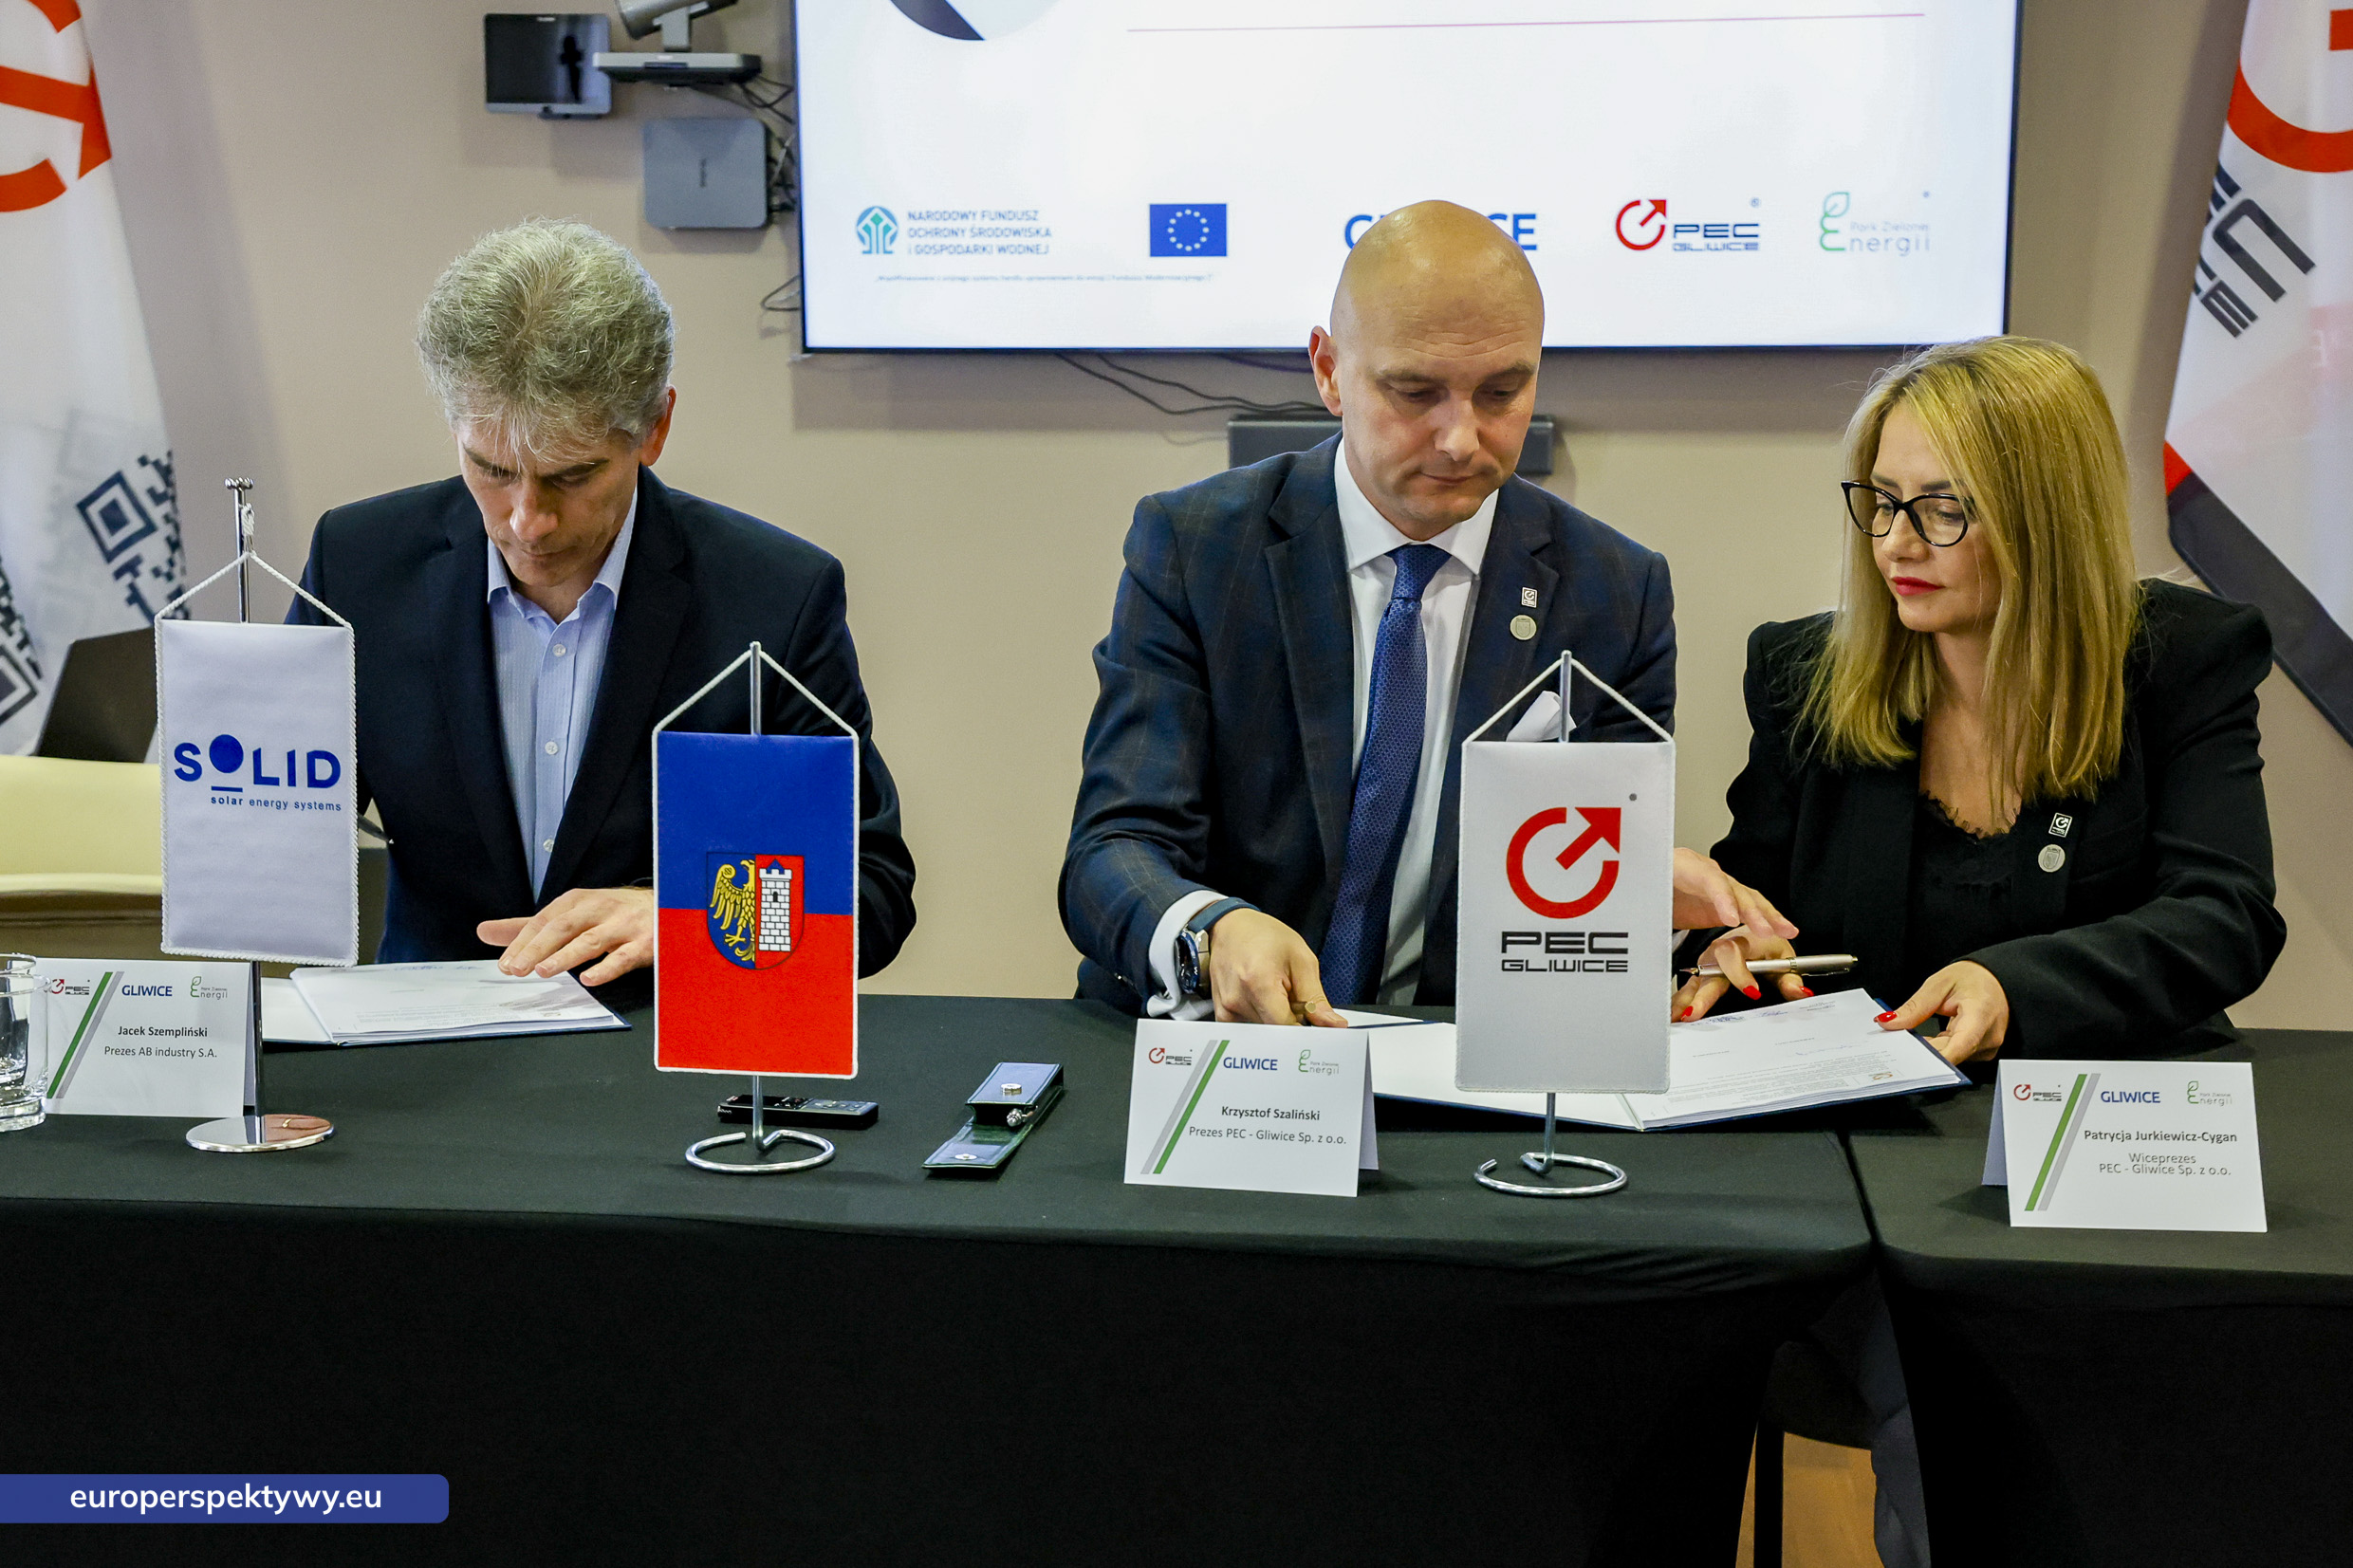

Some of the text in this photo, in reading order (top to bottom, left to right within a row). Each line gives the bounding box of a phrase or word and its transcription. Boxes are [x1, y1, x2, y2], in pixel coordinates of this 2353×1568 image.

[908, 211, 1039, 221] NARODOWY FUNDUSZ
[908, 224, 1052, 238] OCHRONY ŚRODOWISKA
[1674, 224, 1759, 238] PEC
[915, 244, 993, 254] GOSPODARKI
[998, 244, 1049, 254] WODNEJ
[175, 734, 341, 788] SOLID
[211, 796, 342, 811] solar energy systems
[1501, 932, 1628, 954] PEC
[1502, 959, 1628, 972] GLIWICE
[121, 986, 173, 996] GLIWICE
[118, 1026, 208, 1039] Jacek Szempliński
[104, 1046, 217, 1059] Prezes AB industry S.A.
[1223, 1057, 1278, 1070] GLIWICE
[2101, 1091, 2160, 1103] GLIWICE
[1222, 1106, 1320, 1120] Krzysztof Szaliński
[1190, 1127, 1222, 1137] Prezes
[1227, 1129, 1246, 1138] PEC
[1256, 1130, 1295, 1141] Gliwice
[1299, 1133, 1315, 1144] Sp.
[2084, 1131, 2237, 1144] Patrycja Jurkiewicz-Cygan
[2129, 1153, 2196, 1166] Wiceprezes
[2100, 1164, 2121, 1173] PEC
[2132, 1163, 2177, 1174] Gliwice
[2178, 1165, 2196, 1176] Sp.
